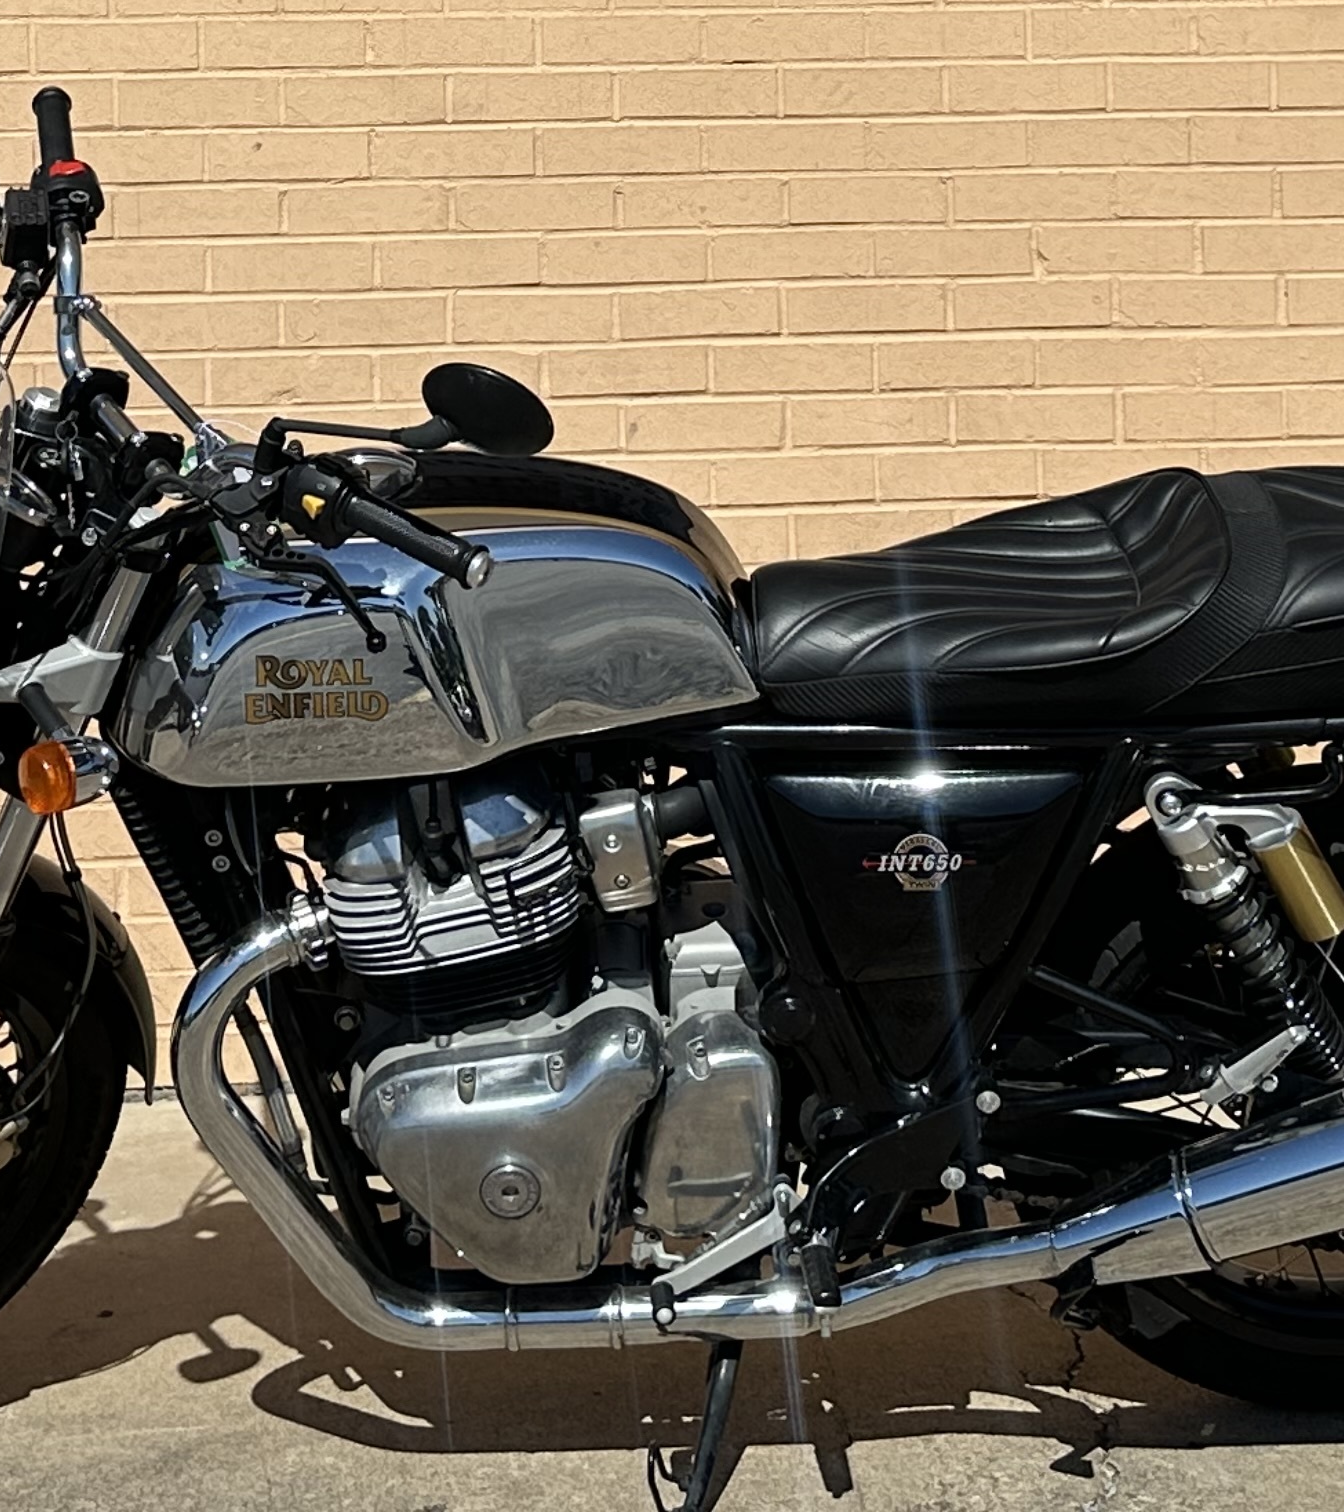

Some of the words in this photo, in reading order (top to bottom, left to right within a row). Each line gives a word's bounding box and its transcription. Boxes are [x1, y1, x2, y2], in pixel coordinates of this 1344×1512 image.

[255, 654, 374, 691] ROYAL
[243, 689, 390, 726] ENFIELD
[877, 853, 963, 873] INT650
